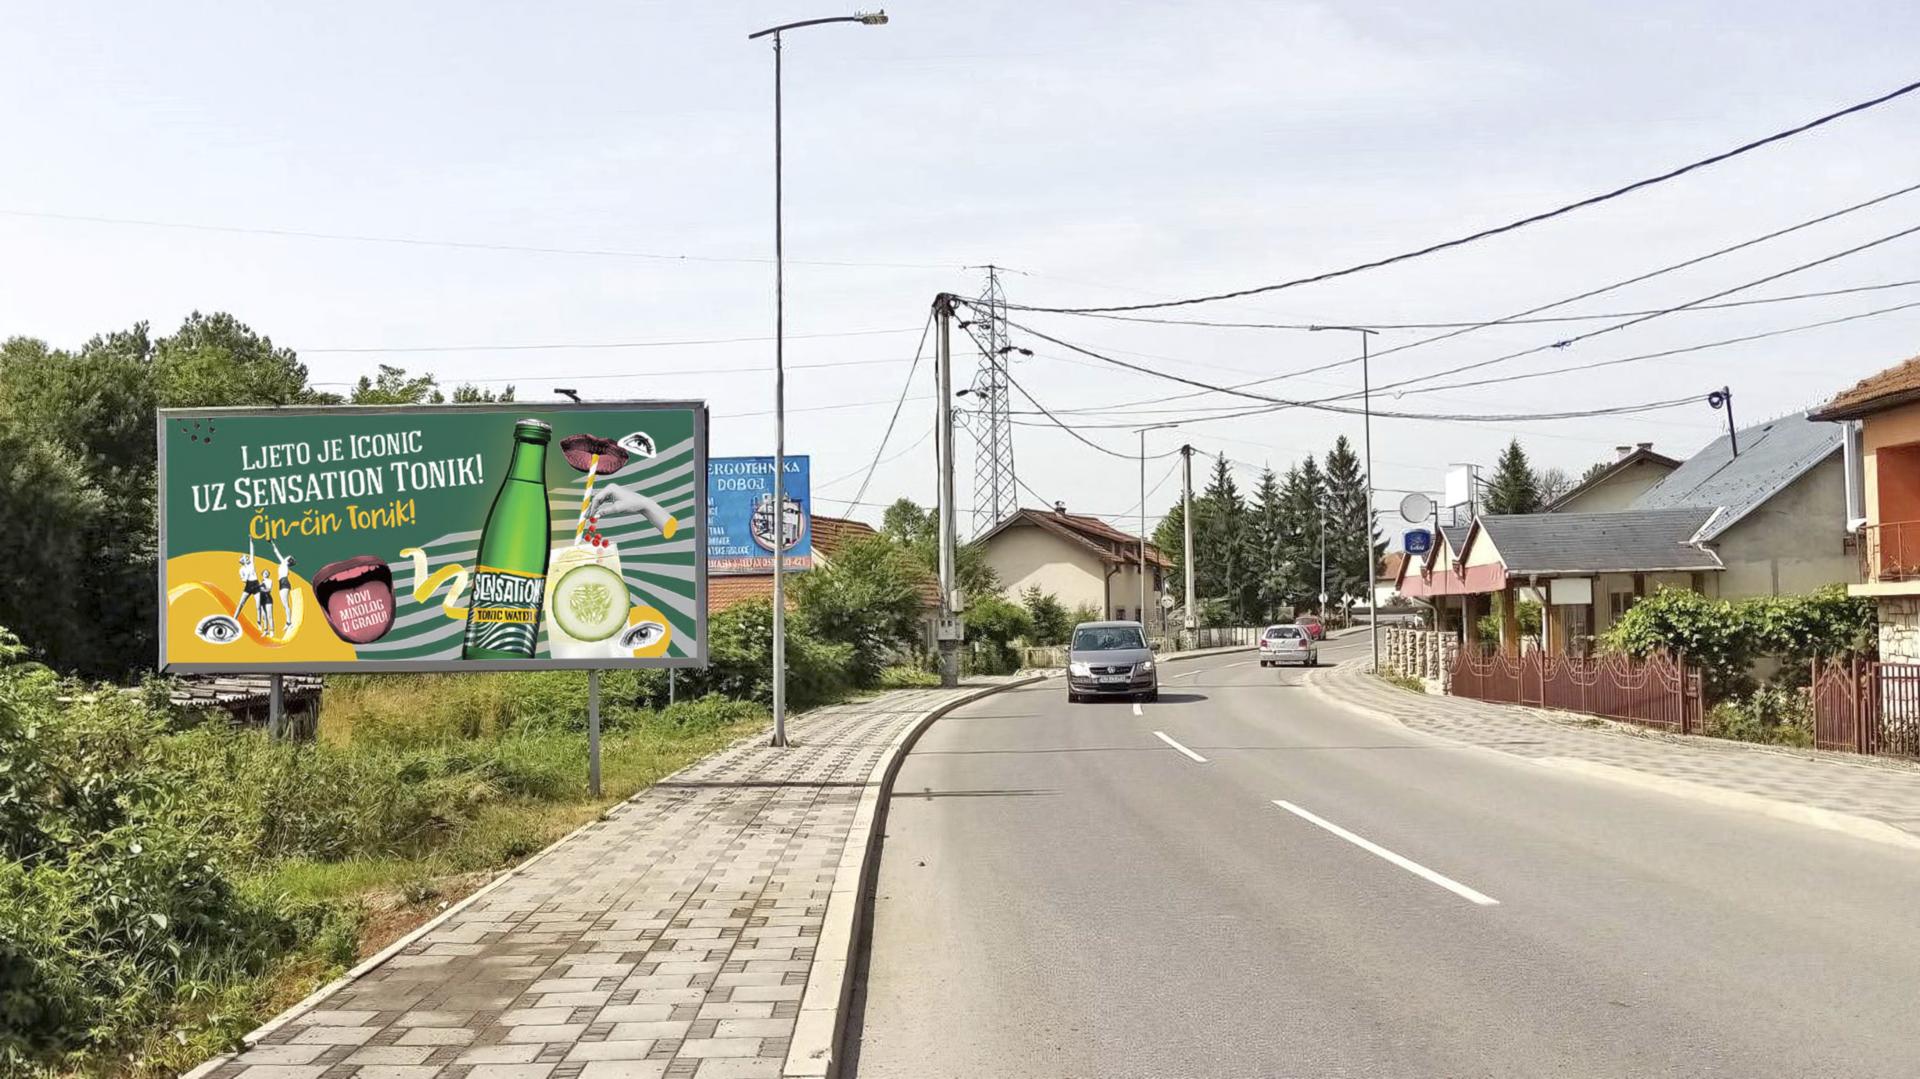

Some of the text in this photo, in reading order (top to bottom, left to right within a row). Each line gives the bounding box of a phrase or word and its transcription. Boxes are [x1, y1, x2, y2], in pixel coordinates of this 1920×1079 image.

[240, 429, 423, 471] LJETO JE ICONIC
[708, 462, 801, 476] ERGOTEHNKA
[191, 453, 484, 513] UZ SENSATION TONIK!
[717, 478, 765, 491] DOBOJ
[346, 498, 417, 530] Tonik!
[345, 589, 371, 606] NOVI
[339, 599, 385, 622] MIXOLOG
[477, 610, 503, 620] TONIC
[342, 621, 350, 633] U
